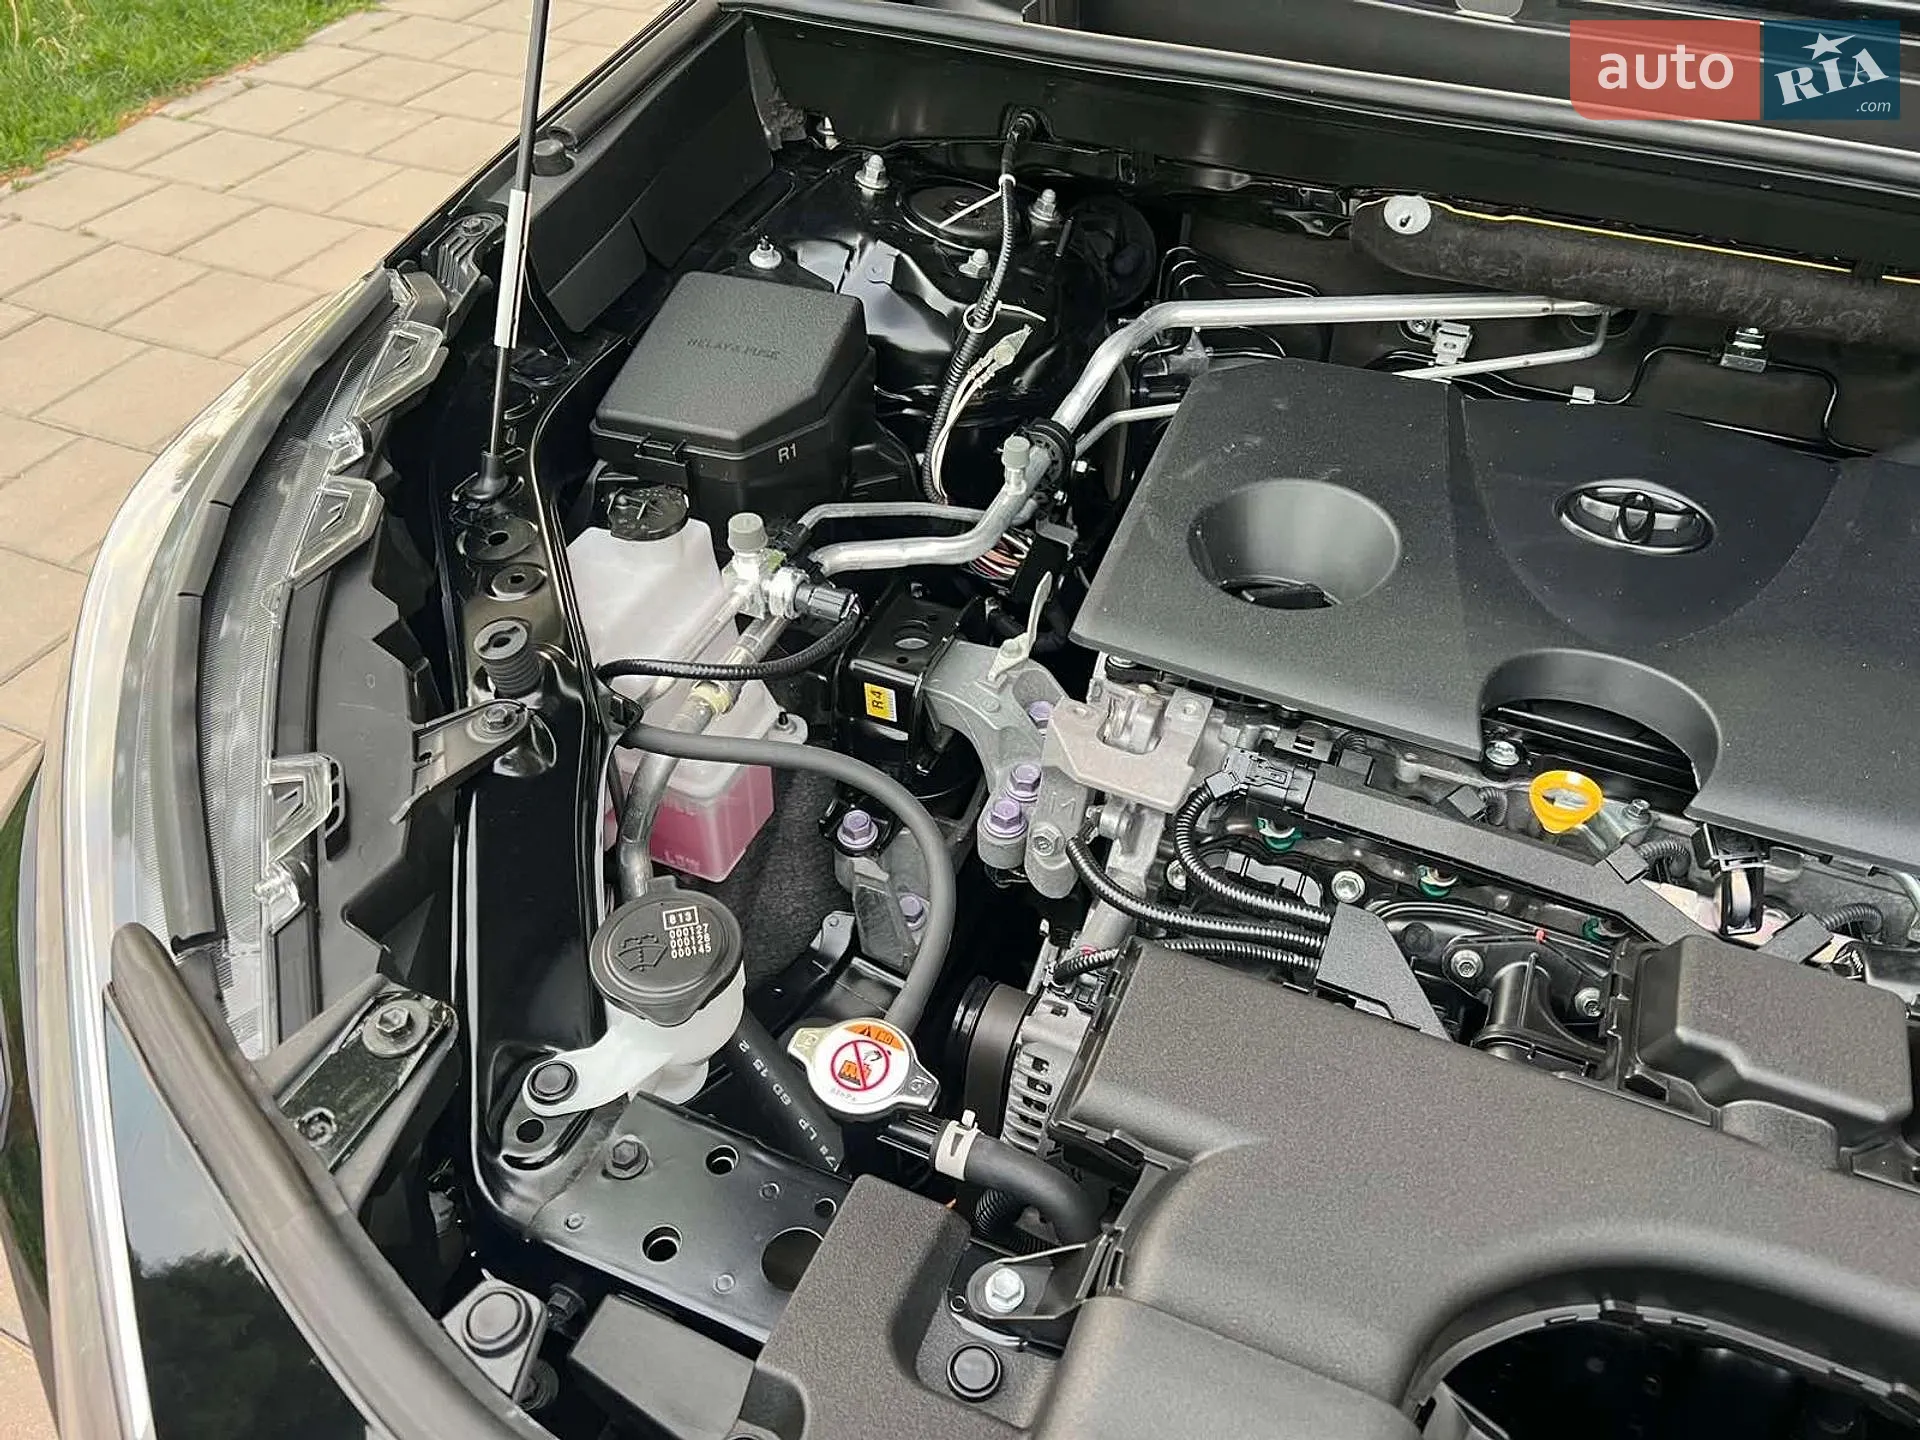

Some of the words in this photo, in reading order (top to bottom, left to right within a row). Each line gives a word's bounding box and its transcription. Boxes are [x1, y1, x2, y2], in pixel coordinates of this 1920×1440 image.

[777, 442, 797, 463] R1
[870, 690, 884, 709] R4
[669, 911, 692, 925] 813
[669, 923, 709, 939] 000127
[740, 1040, 750, 1053] 2
